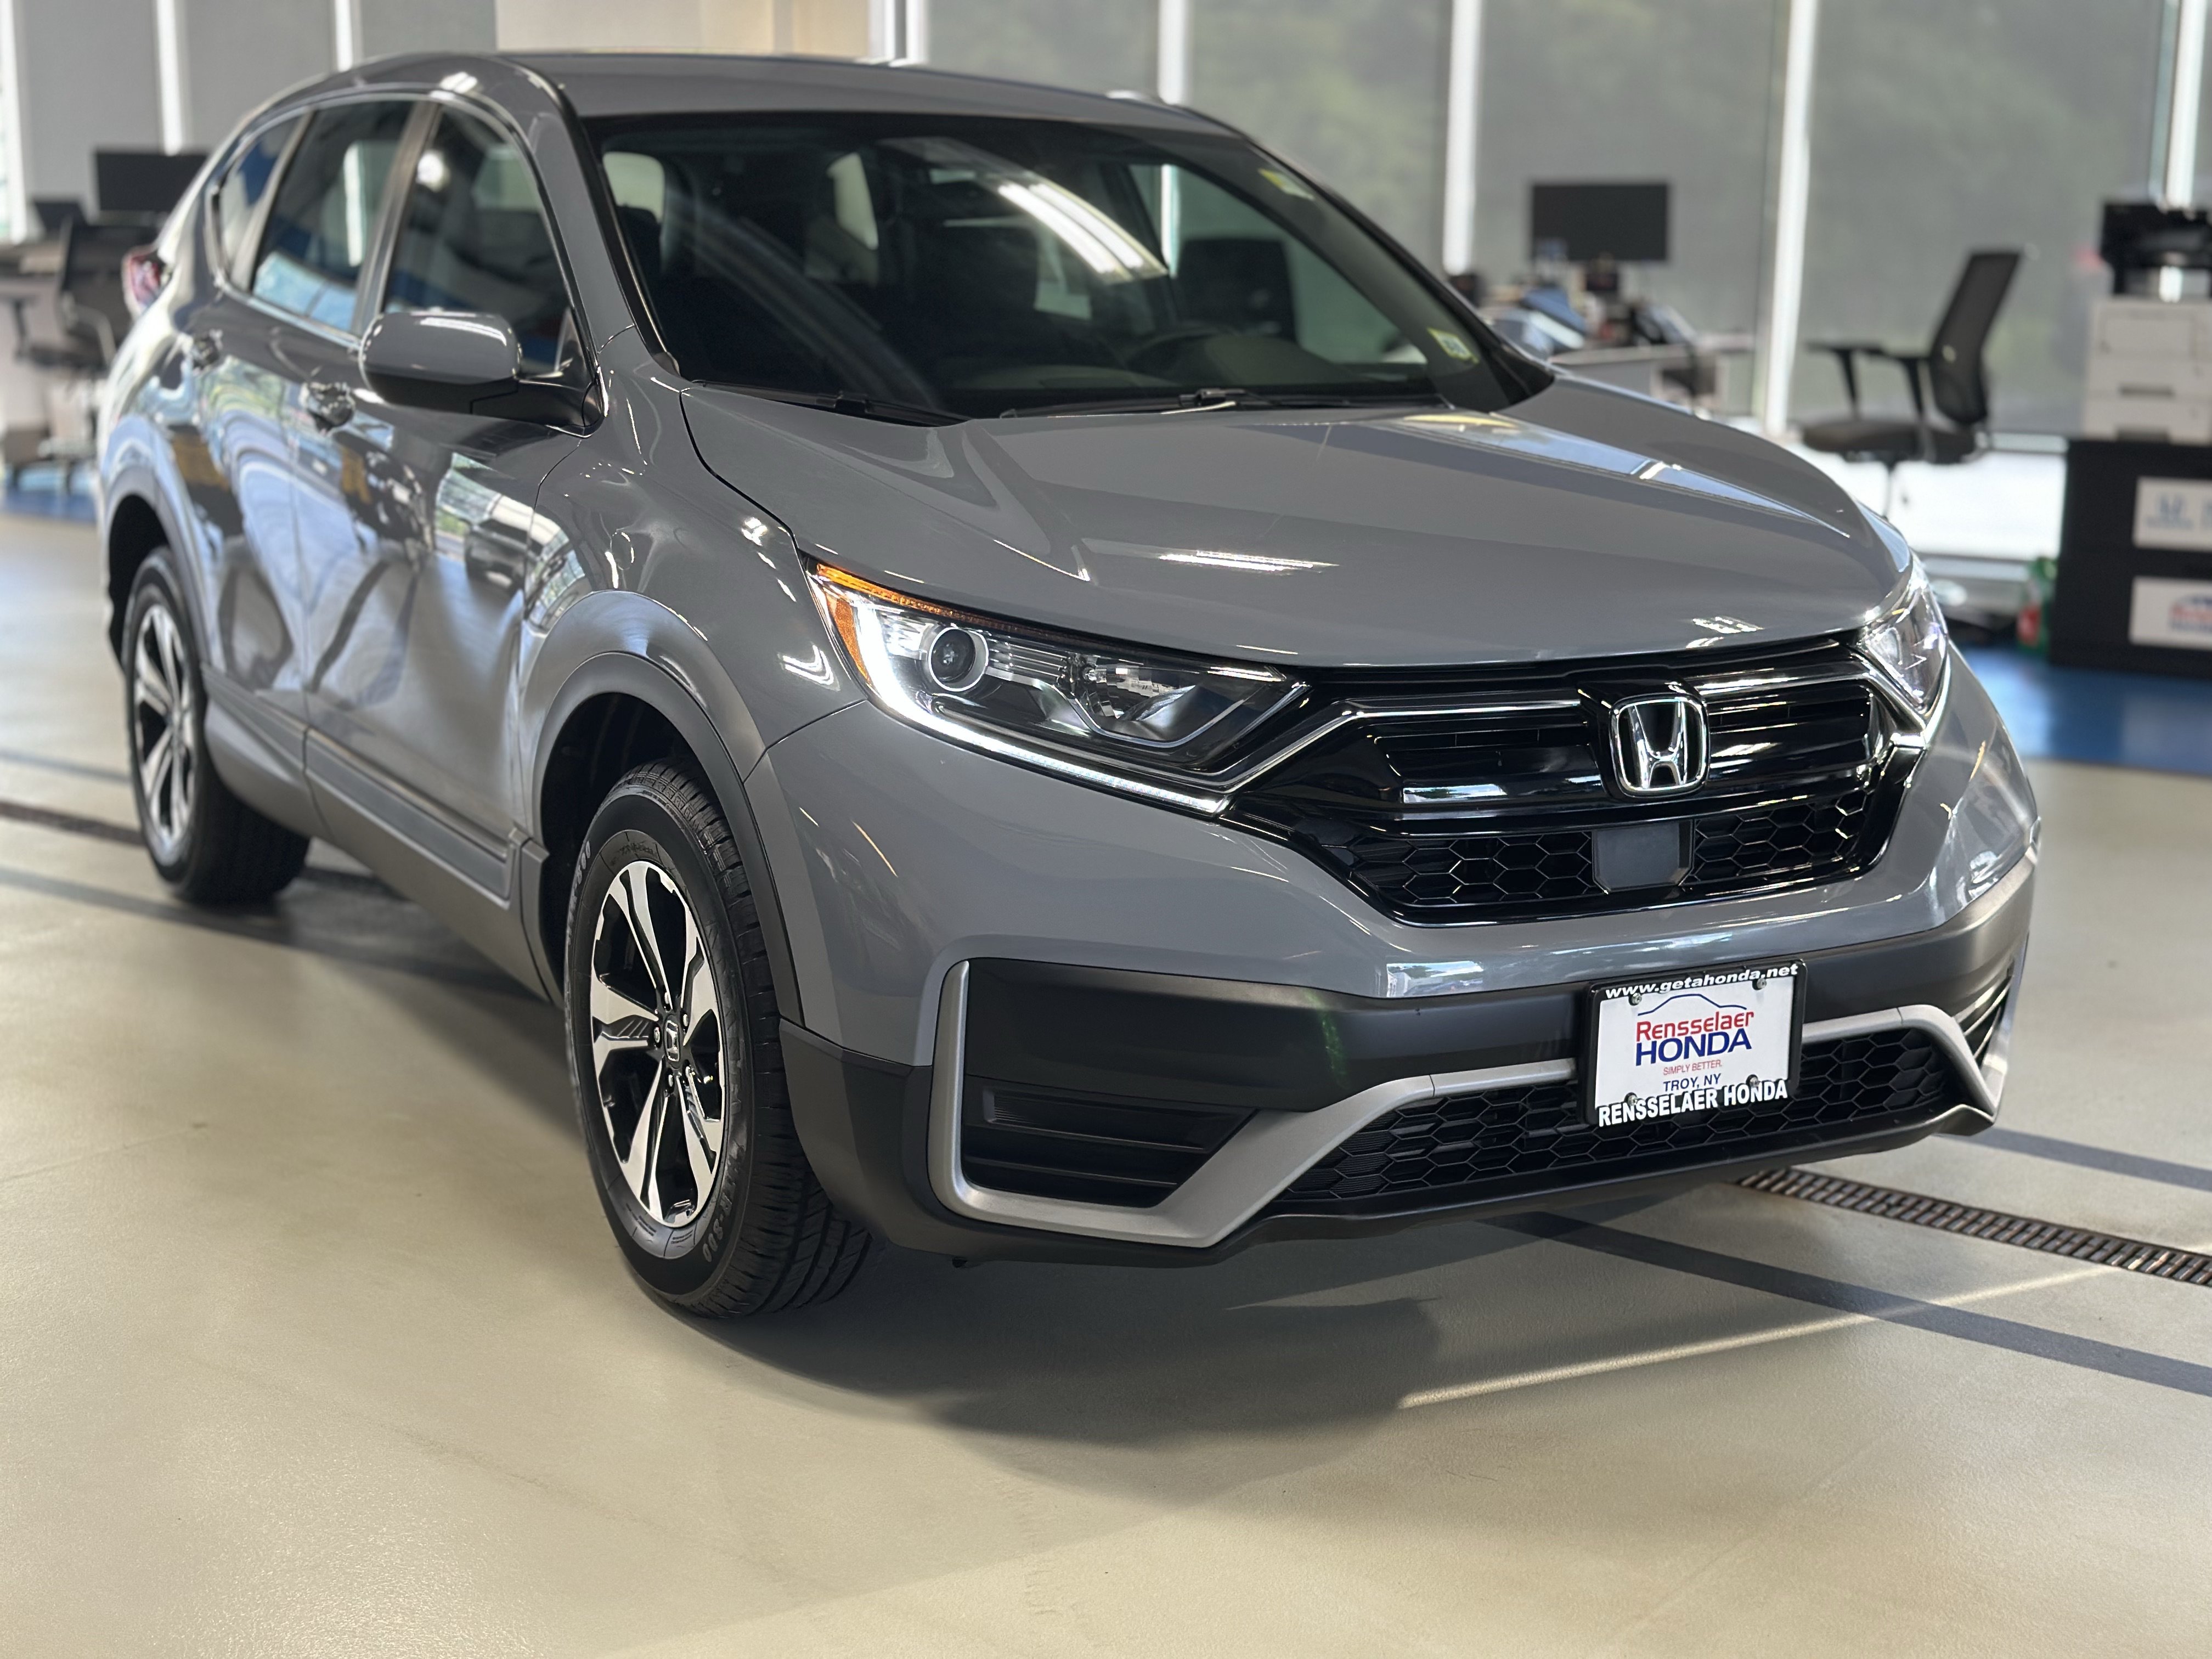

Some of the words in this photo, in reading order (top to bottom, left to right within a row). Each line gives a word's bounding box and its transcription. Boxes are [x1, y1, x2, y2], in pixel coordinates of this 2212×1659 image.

[1605, 963, 1798, 998] www.getahonda.net
[1636, 1011, 1754, 1042] Rensselaer
[1635, 1028, 1752, 1066] HONDA
[1663, 1064, 1690, 1075] SIMPLY
[1663, 1076, 1700, 1092] TROY,
[1703, 1073, 1722, 1086] NY
[1599, 1088, 1718, 1127] RENSSELAER
[1724, 1078, 1788, 1106] HONDA
